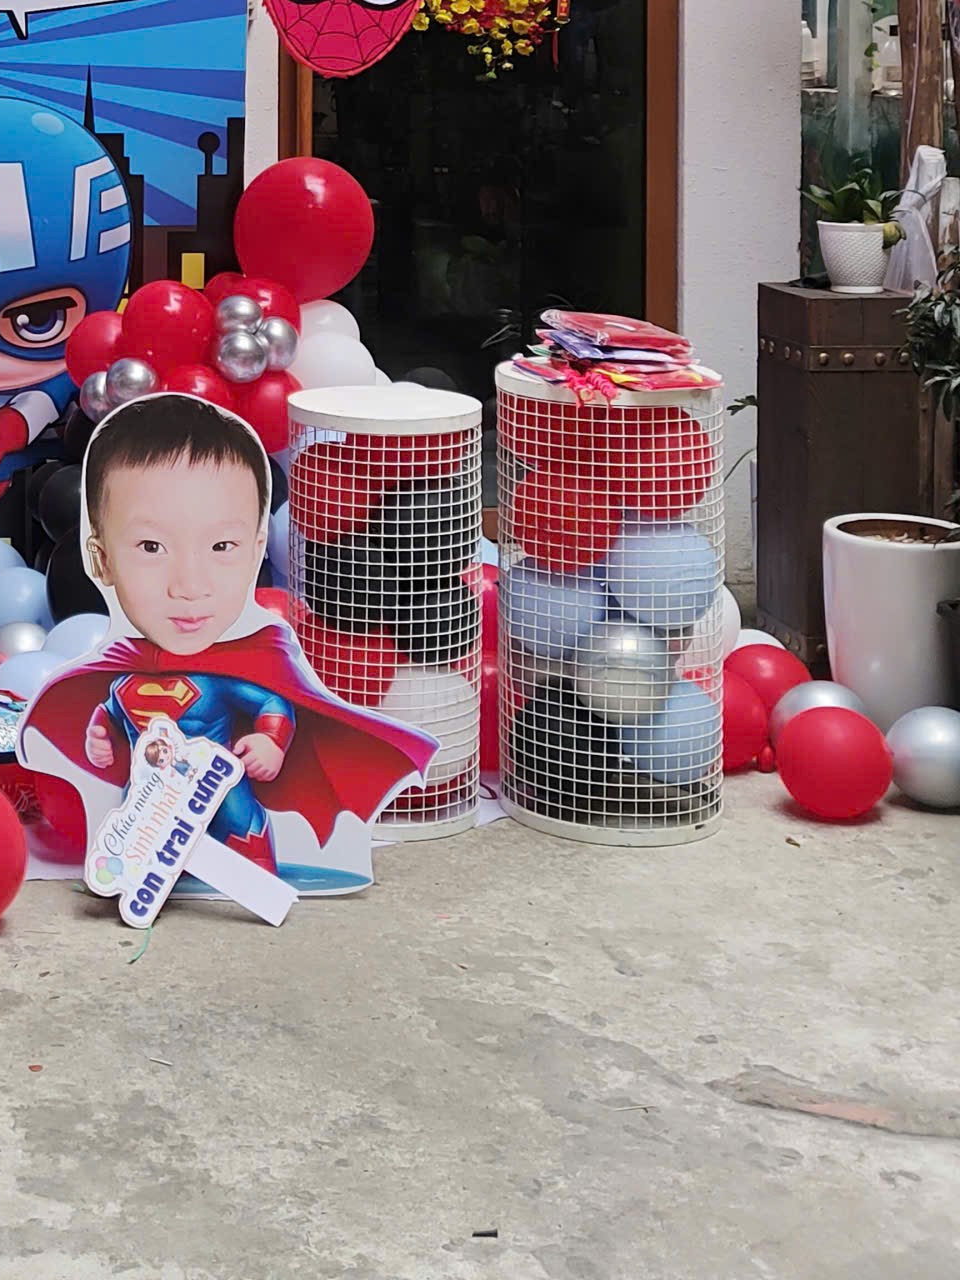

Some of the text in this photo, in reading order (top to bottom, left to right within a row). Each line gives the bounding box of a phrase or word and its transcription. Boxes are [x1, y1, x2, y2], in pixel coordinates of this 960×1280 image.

[129, 753, 235, 918] con trai cưng
